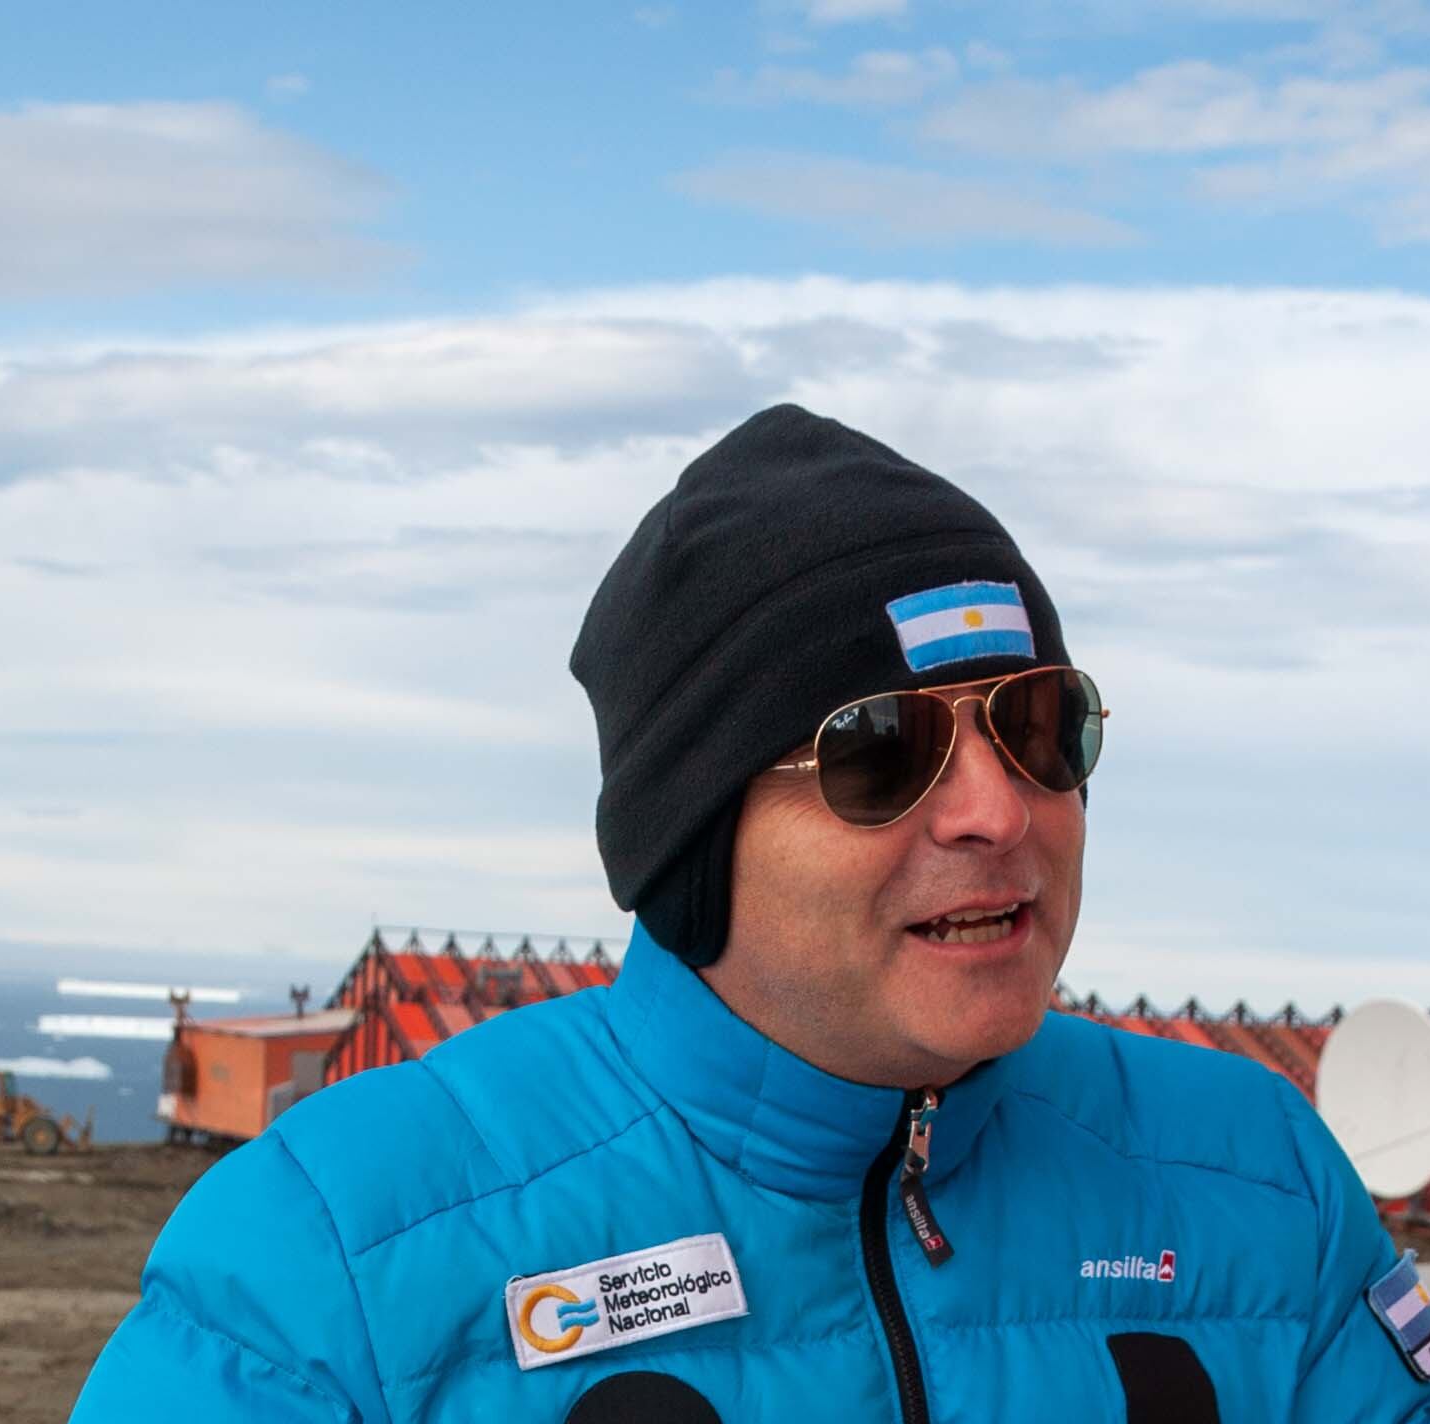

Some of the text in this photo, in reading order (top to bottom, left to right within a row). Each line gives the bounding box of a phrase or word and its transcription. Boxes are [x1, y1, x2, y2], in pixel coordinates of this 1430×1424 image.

[599, 1261, 672, 1293] Servicio
[603, 1270, 732, 1314] Meteorológico
[607, 1297, 691, 1334] Nacional
